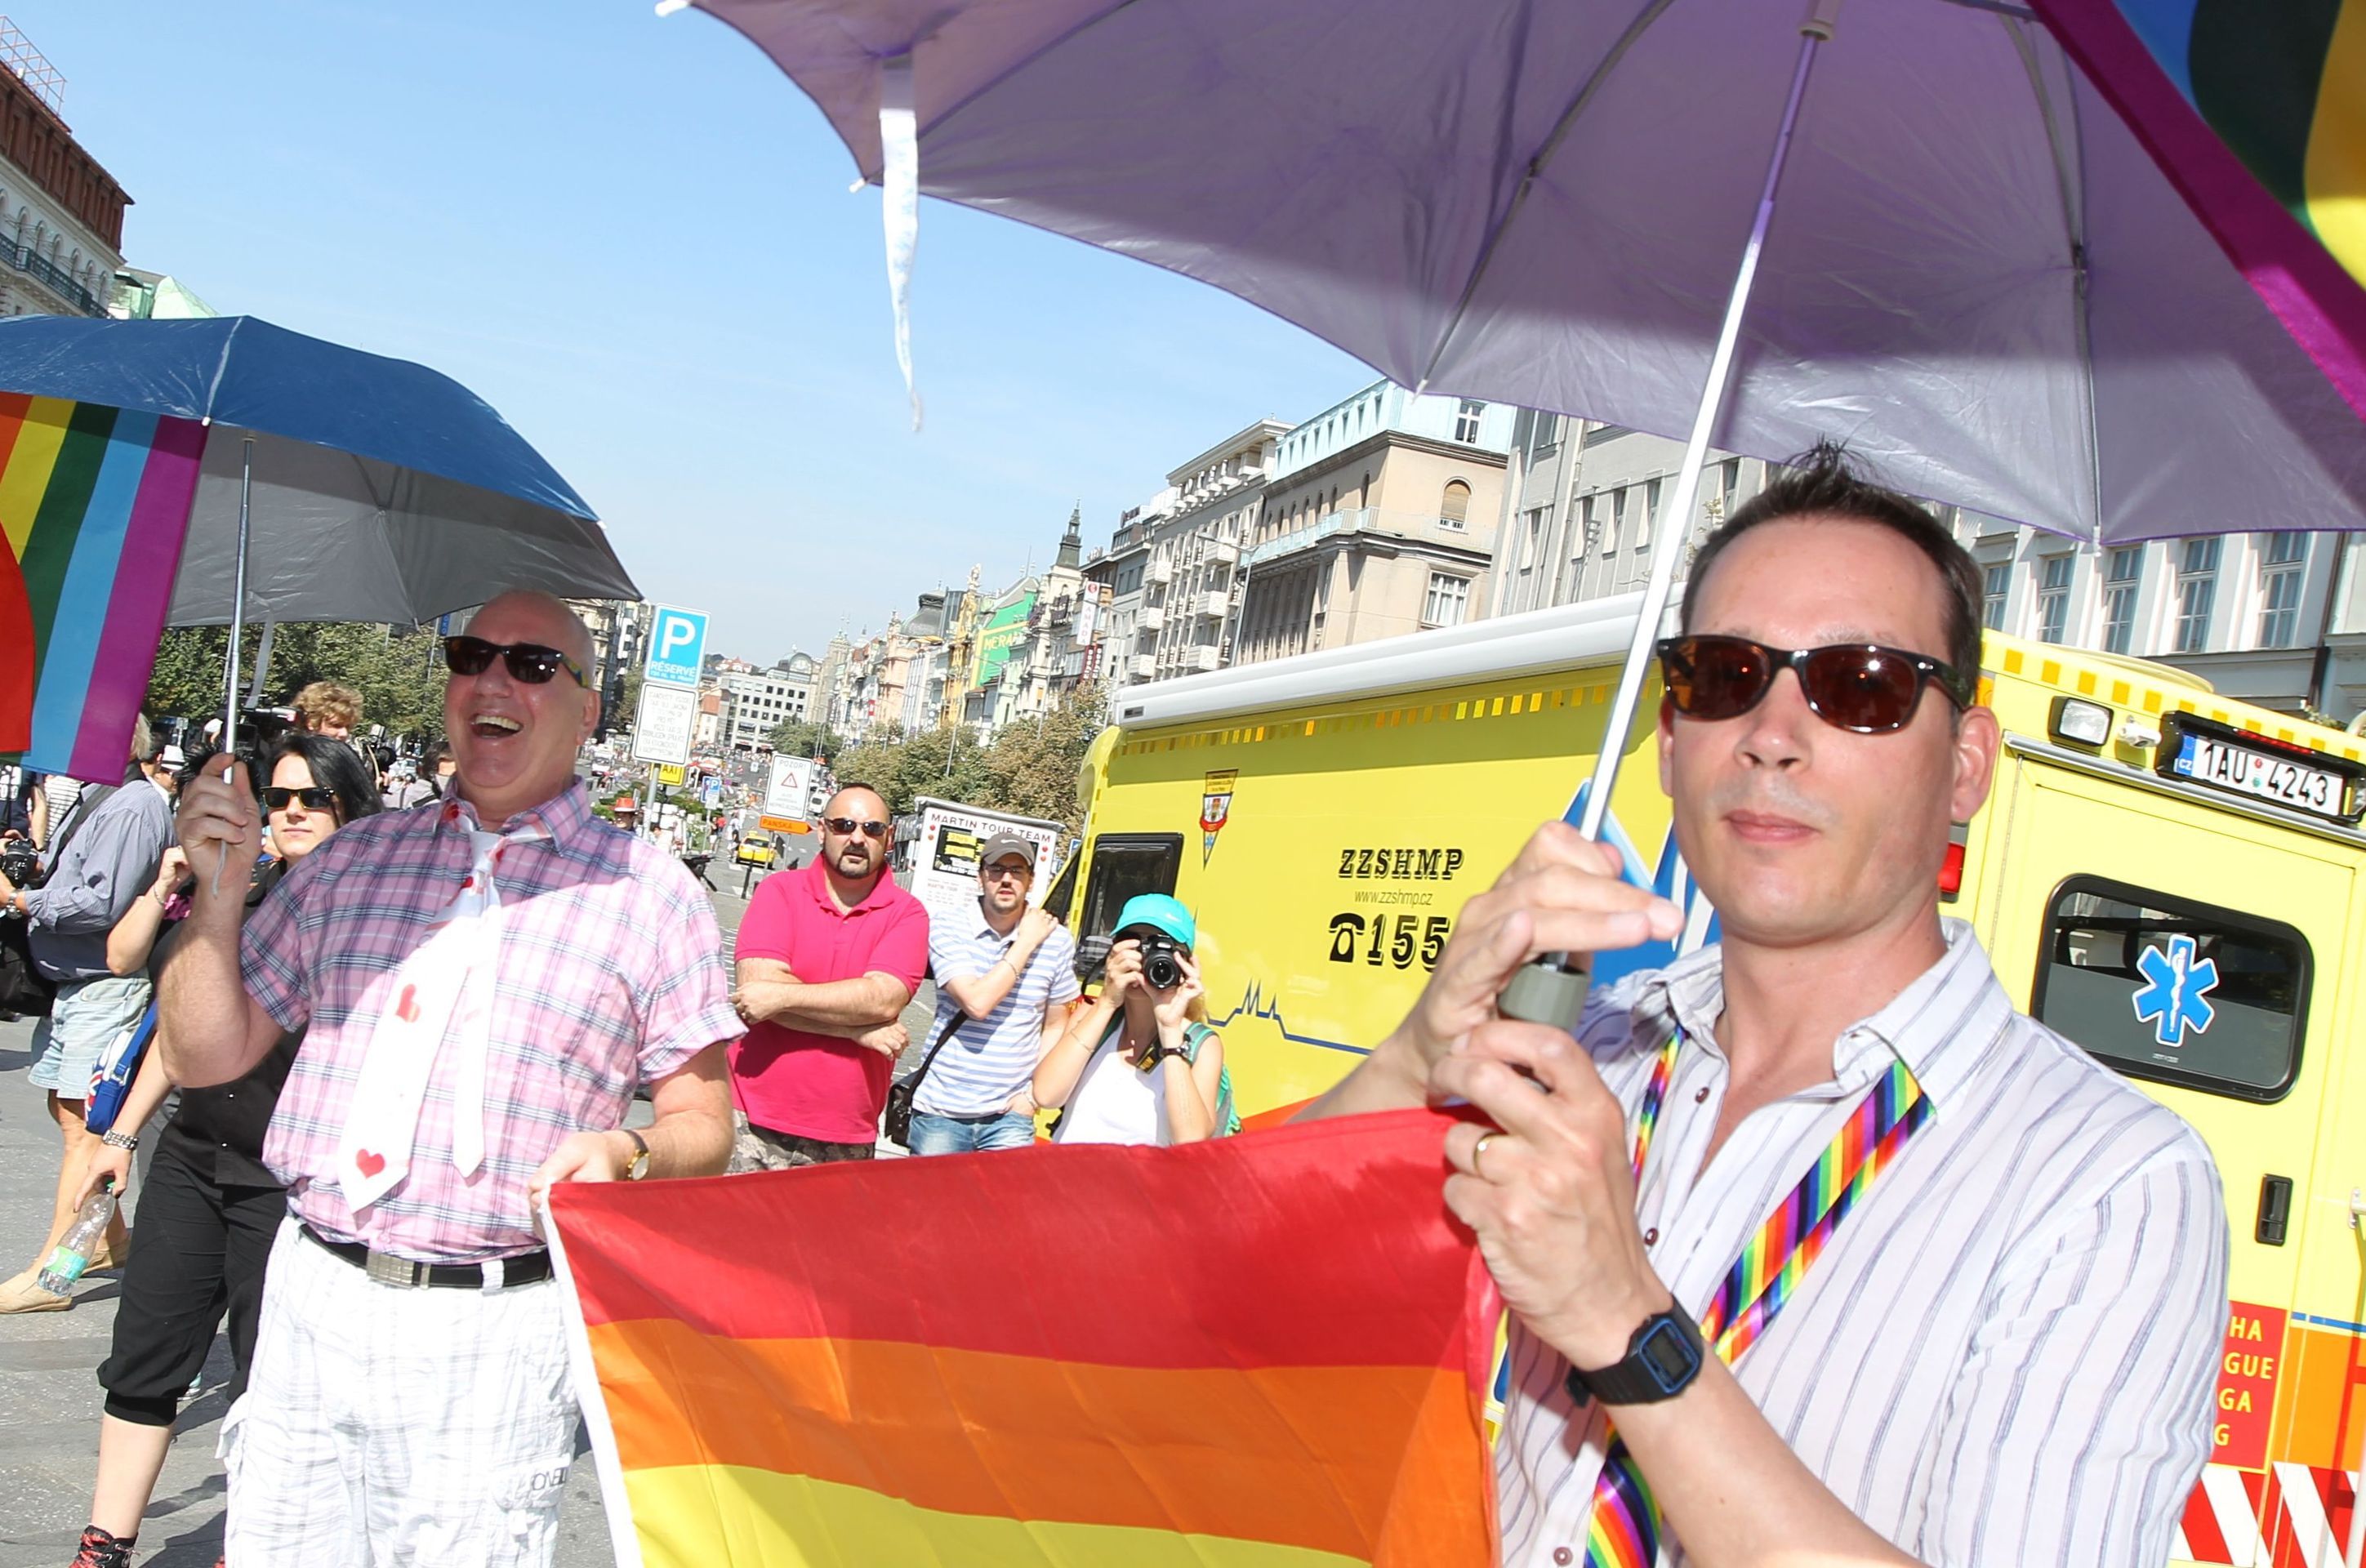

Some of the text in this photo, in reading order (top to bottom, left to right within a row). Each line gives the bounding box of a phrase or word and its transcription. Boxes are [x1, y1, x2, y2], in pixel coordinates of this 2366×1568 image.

[660, 616, 697, 659] P
[651, 660, 697, 677] RÉSERVÉ
[2178, 758, 2193, 771] CZ
[2203, 743, 2328, 806] 1AU 4243
[931, 813, 1051, 842] MARTIN TOUR TEAM
[1338, 849, 1464, 880] ZZSHMP
[1354, 889, 1433, 908] www.zzshmp.cz
[1367, 914, 1450, 973] 155
[2228, 1315, 2262, 1342] HA
[2223, 1352, 2275, 1380] GUE
[2218, 1388, 2252, 1414] GA
[2213, 1423, 2231, 1446] G
